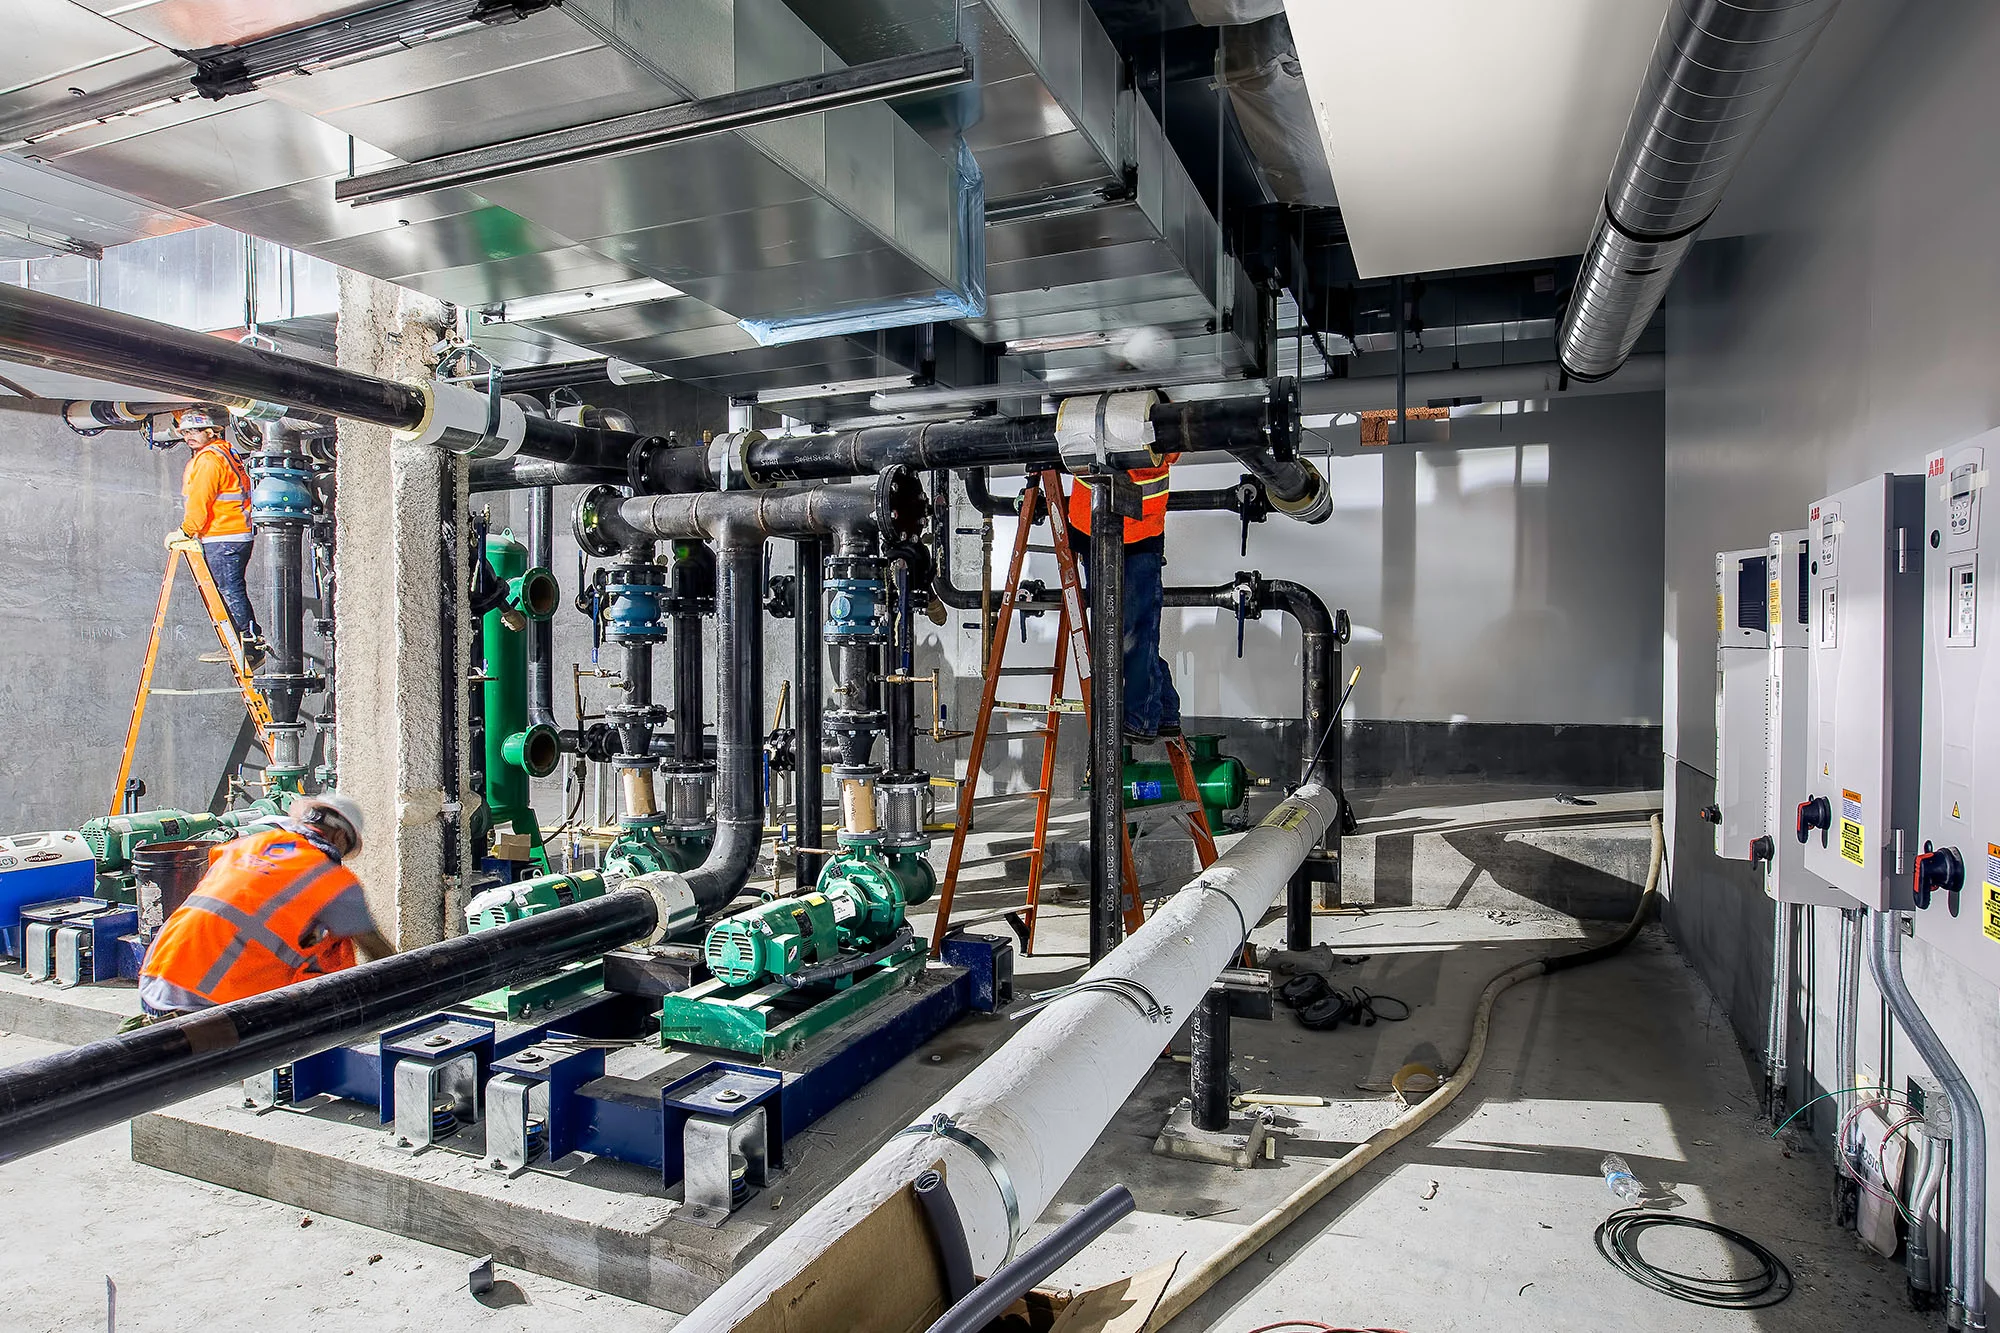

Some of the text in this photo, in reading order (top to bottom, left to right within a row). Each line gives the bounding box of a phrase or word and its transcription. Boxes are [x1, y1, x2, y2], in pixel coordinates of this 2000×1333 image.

[1928, 457, 1945, 478] ABB
[1810, 506, 1820, 521] ABB
[1106, 594, 1114, 618] MADE
[1106, 624, 1114, 634] IN
[1106, 672, 1114, 711] HYUNDAI
[1106, 716, 1114, 745] HYSCO
[1106, 749, 1114, 773] SPEC
[1106, 856, 1115, 879] 2014
